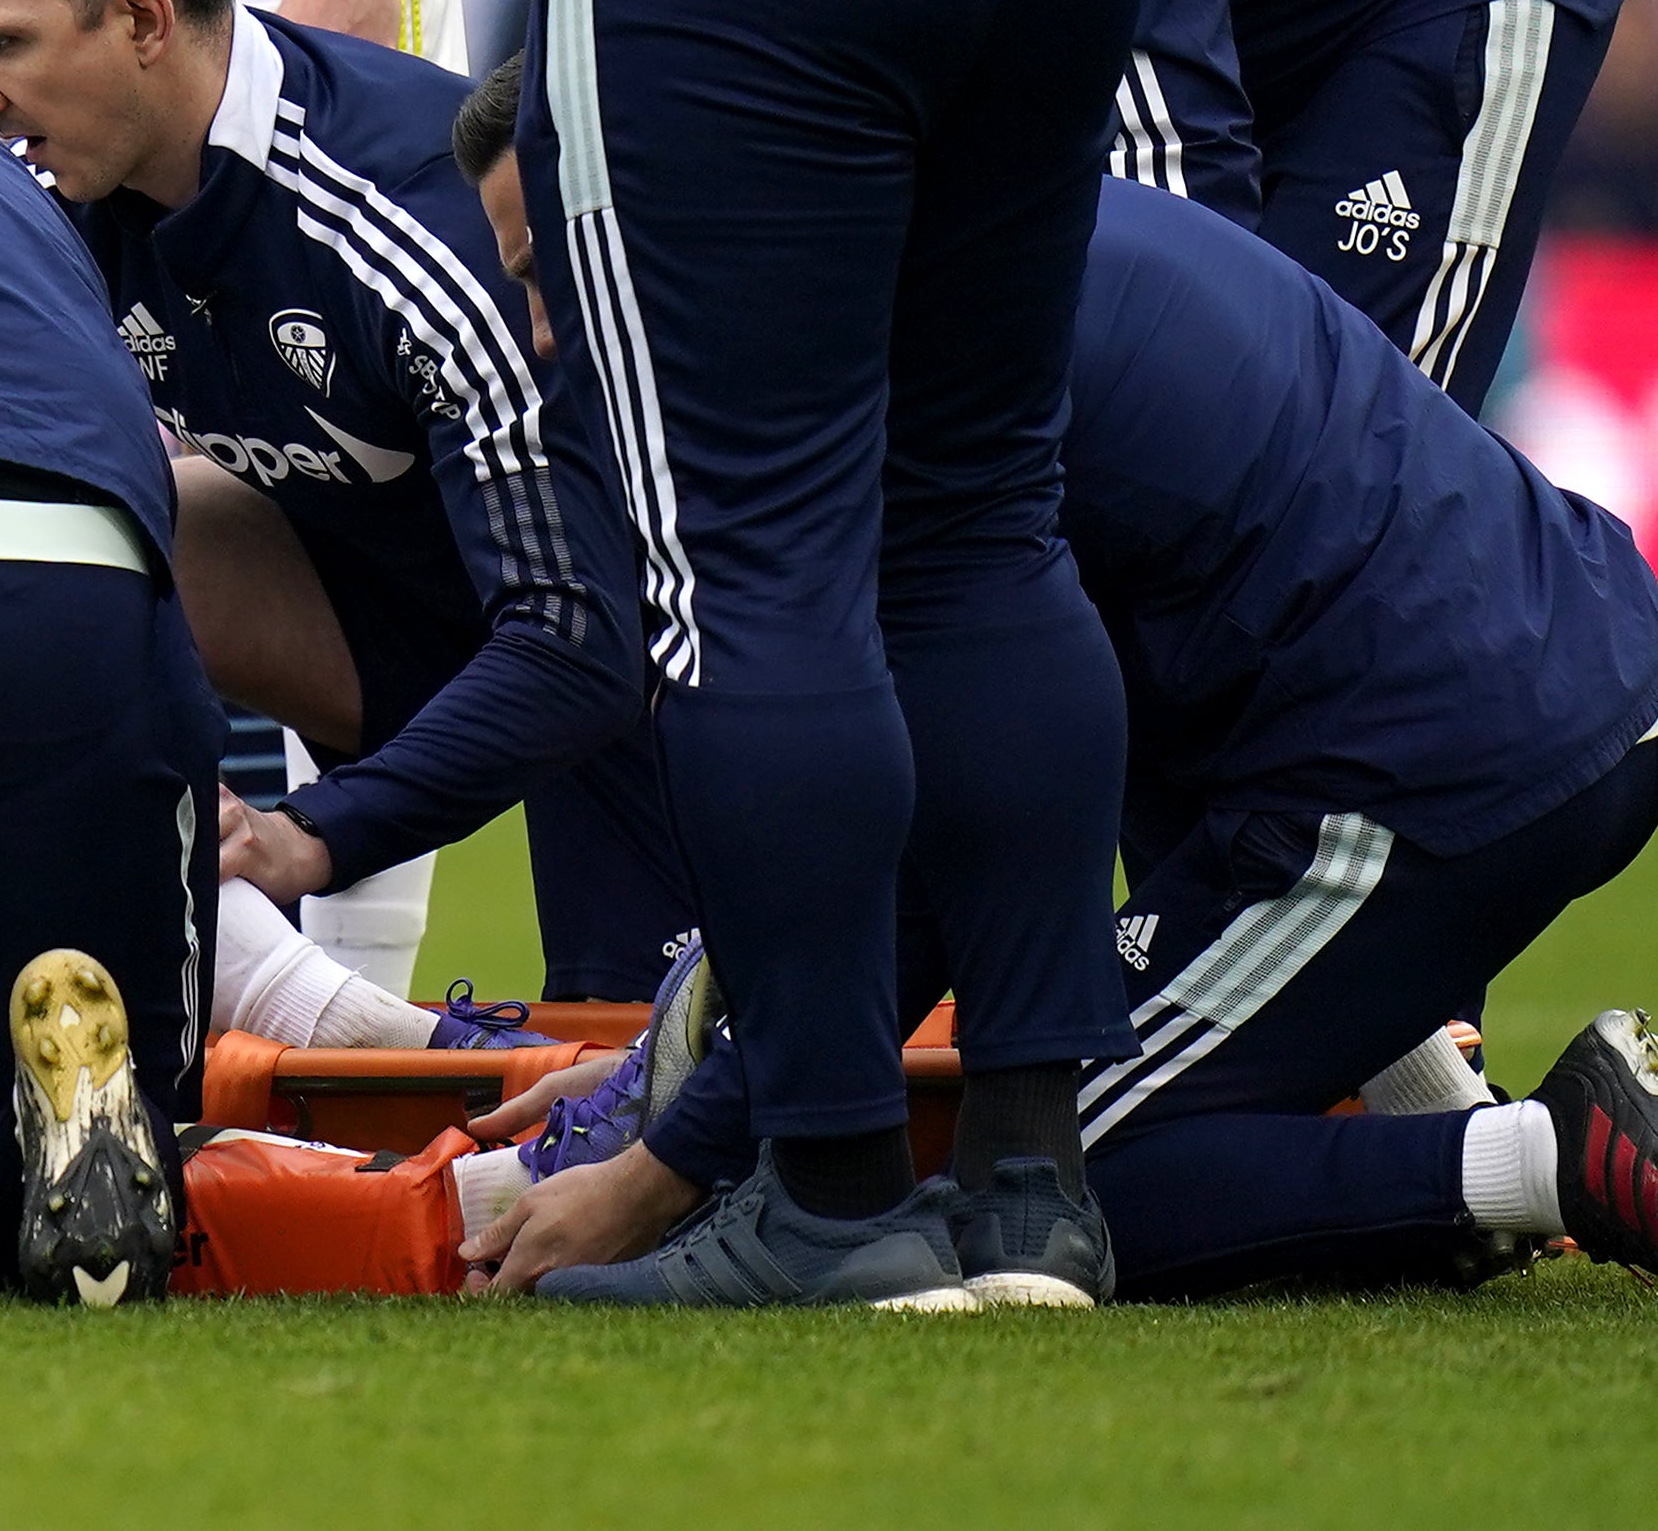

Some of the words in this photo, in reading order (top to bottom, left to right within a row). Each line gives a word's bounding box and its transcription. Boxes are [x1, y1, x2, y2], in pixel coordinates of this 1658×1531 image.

[1335, 199, 1421, 230] adidas
[1337, 220, 1411, 262] JO'S
[124, 334, 177, 353] didas
[138, 355, 169, 382] NF
